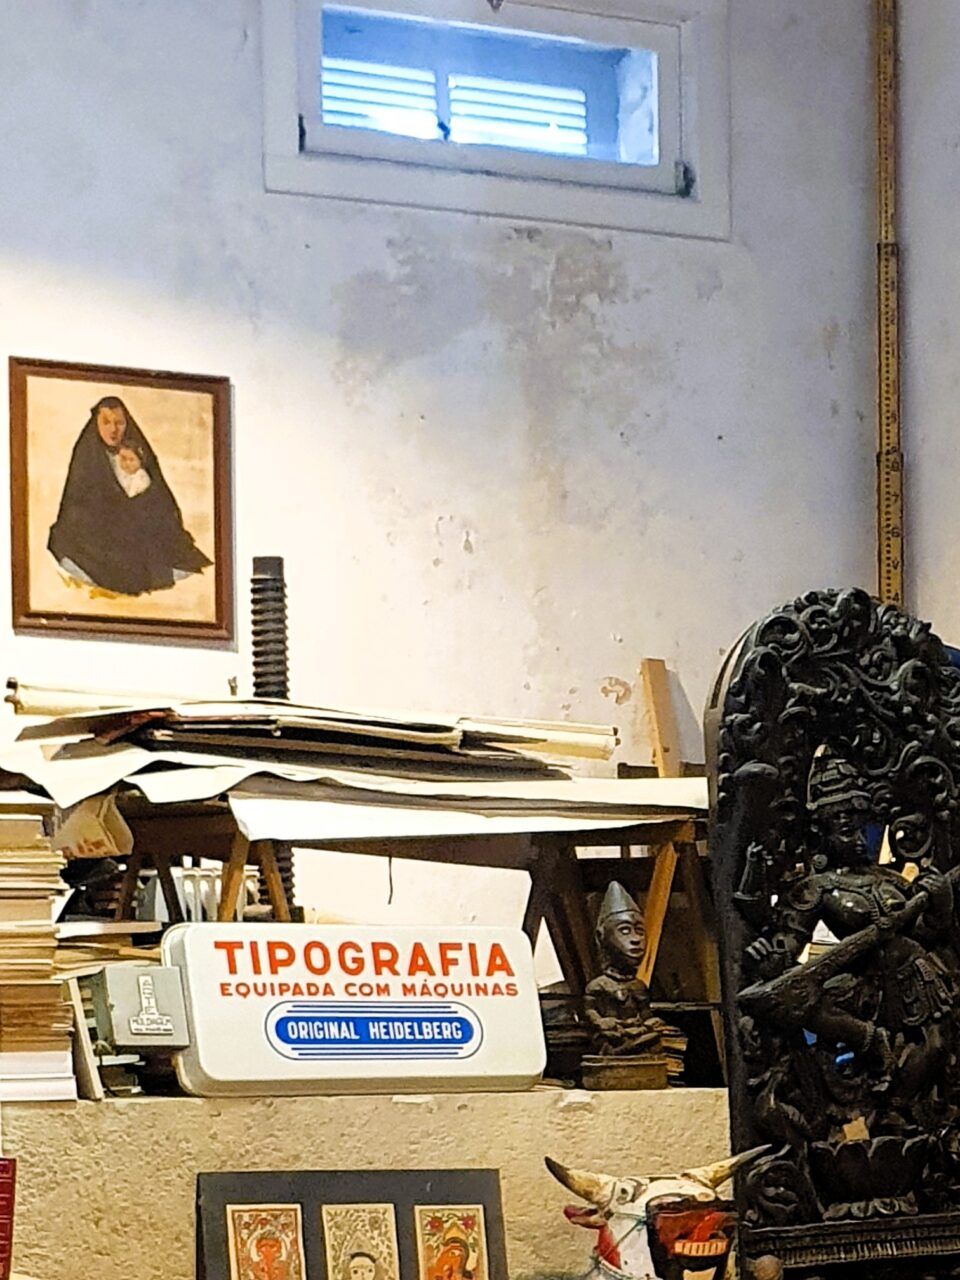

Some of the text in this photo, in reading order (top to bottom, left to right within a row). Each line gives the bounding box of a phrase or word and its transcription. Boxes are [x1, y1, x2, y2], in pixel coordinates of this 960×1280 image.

[214, 940, 516, 977] TIPOGRAFIA
[219, 978, 519, 998] EQUIPADA COM MÁQUINAS
[287, 1021, 463, 1040] ORIGINAL HEIDELBERG
